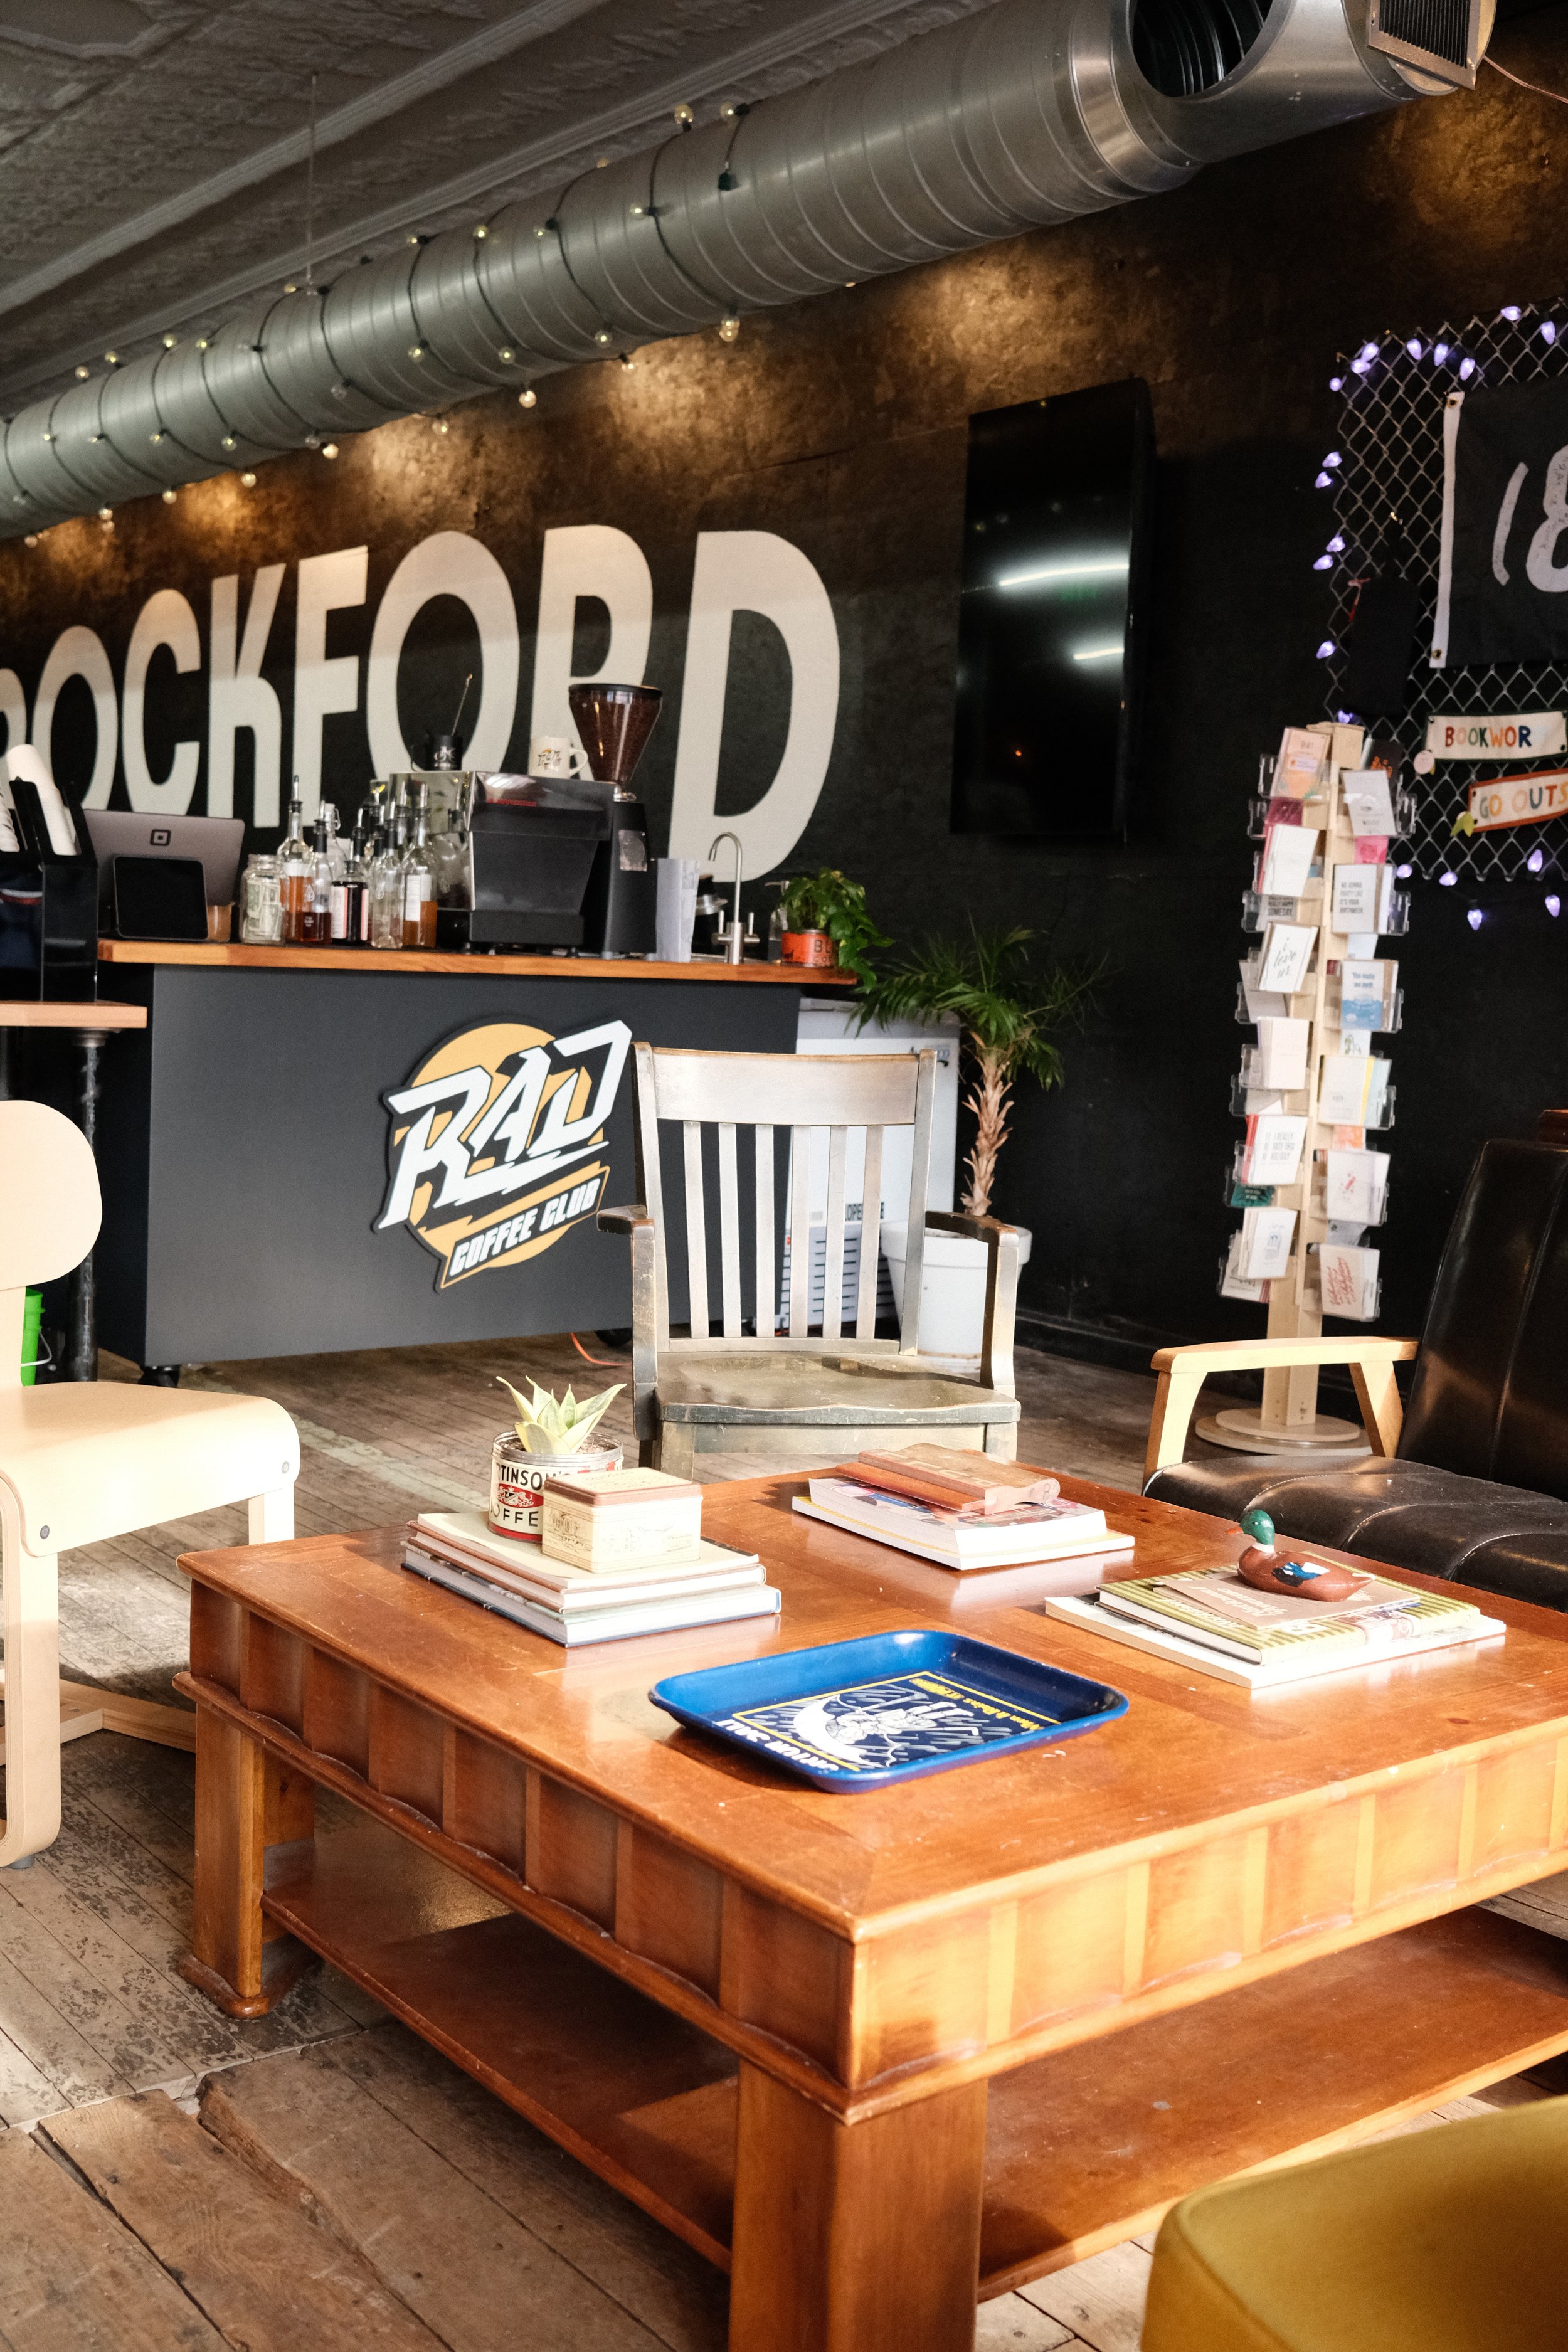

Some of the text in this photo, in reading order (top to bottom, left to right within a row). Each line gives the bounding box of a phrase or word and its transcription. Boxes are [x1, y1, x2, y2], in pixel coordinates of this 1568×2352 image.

[1480, 793, 1503, 819] GO
[378, 1019, 633, 1229] RAD
[449, 1178, 601, 1277] COFFEE CLUB
[490, 1504, 539, 1527] OFFE
